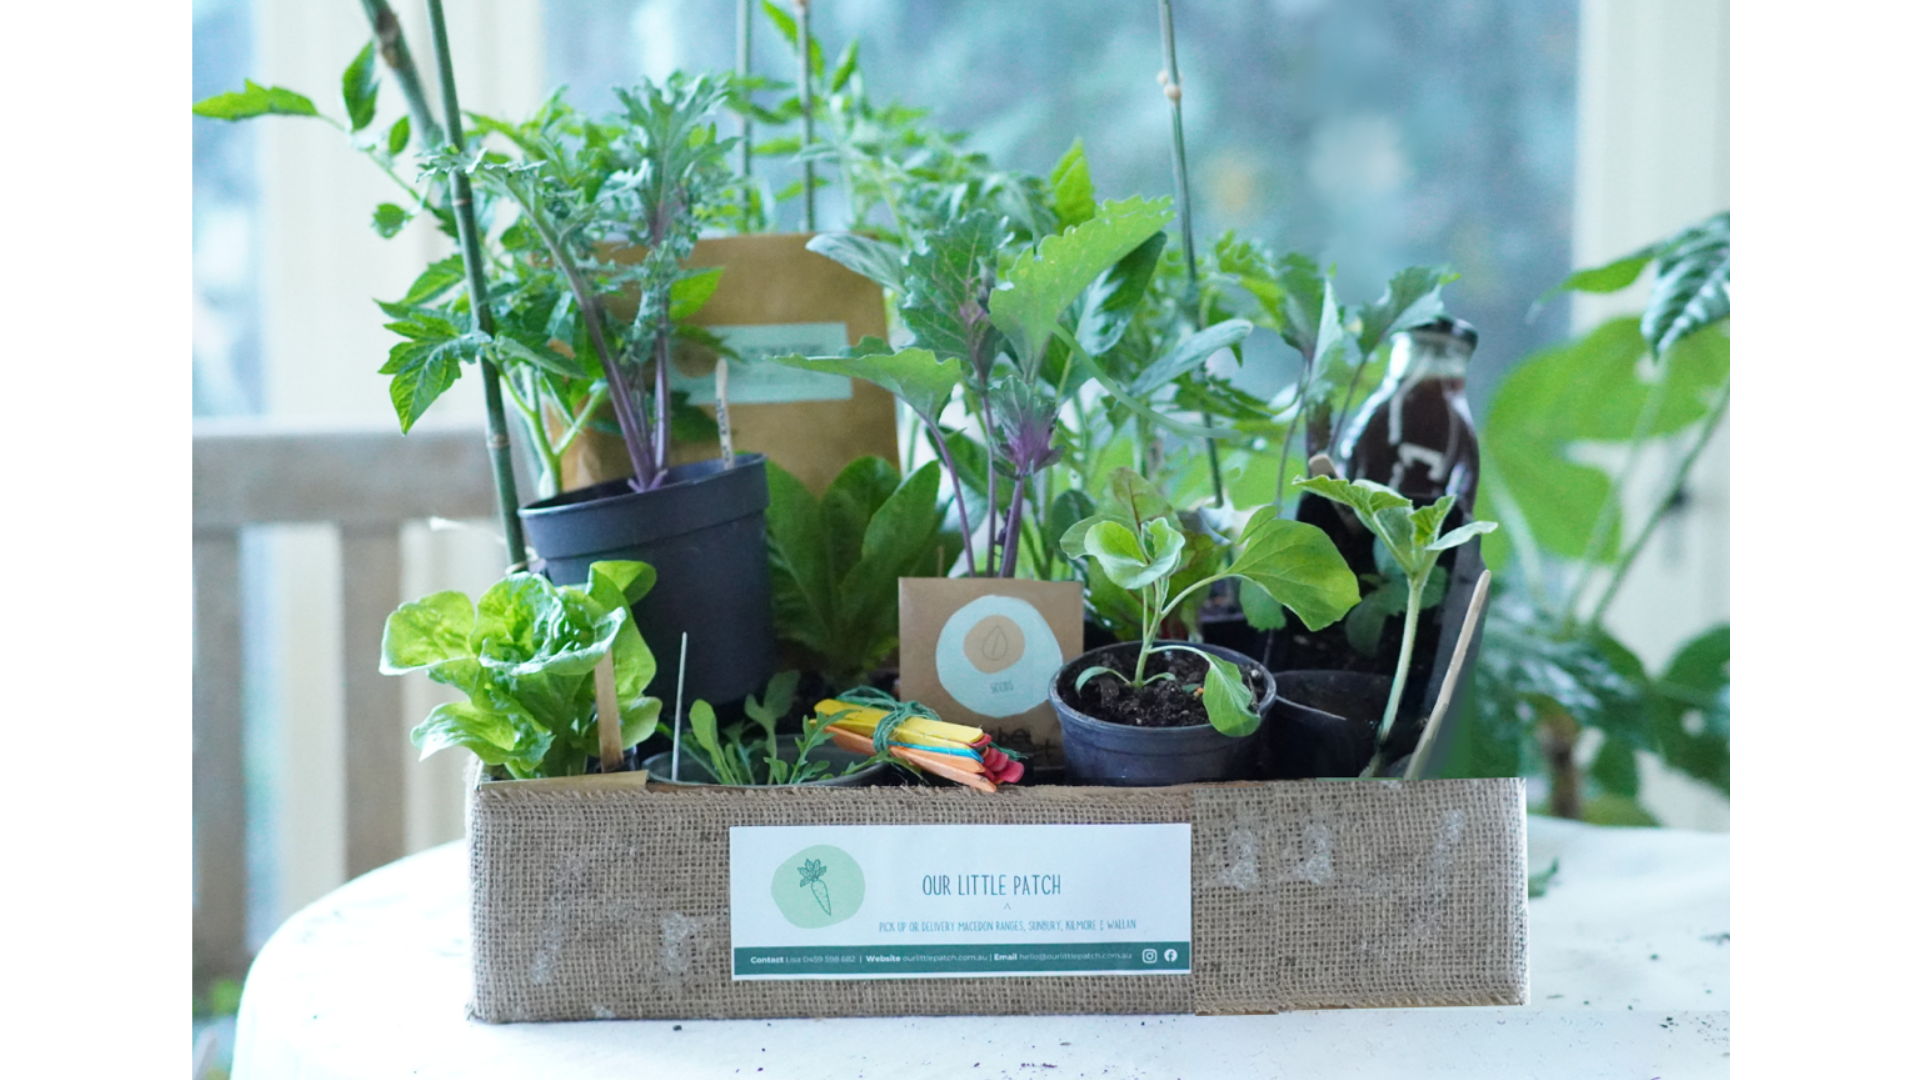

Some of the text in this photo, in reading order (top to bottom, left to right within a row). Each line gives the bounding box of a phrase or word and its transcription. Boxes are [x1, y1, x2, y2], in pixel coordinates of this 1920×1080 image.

[990, 680, 1014, 694] SEEDS
[922, 874, 1061, 896] OUR LITTLE PATCH
[879, 921, 895, 932] PICK
[897, 921, 907, 932] UP
[909, 921, 919, 932] OR
[921, 921, 955, 932] DELIVERY
[958, 920, 994, 932] MACEDON
[996, 920, 1026, 933] RANGES,
[1028, 920, 1064, 932] SUNBURY,
[1065, 919, 1096, 931] KILMORE
[1107, 918, 1137, 930] WALLAN
[750, 956, 784, 964] Contact
[865, 954, 901, 962] Website
[902, 953, 988, 963] ourlittlepatch.com.au
[994, 952, 1017, 961] Email
[1019, 951, 1133, 961] hello@ourlittlepatch.com.au
